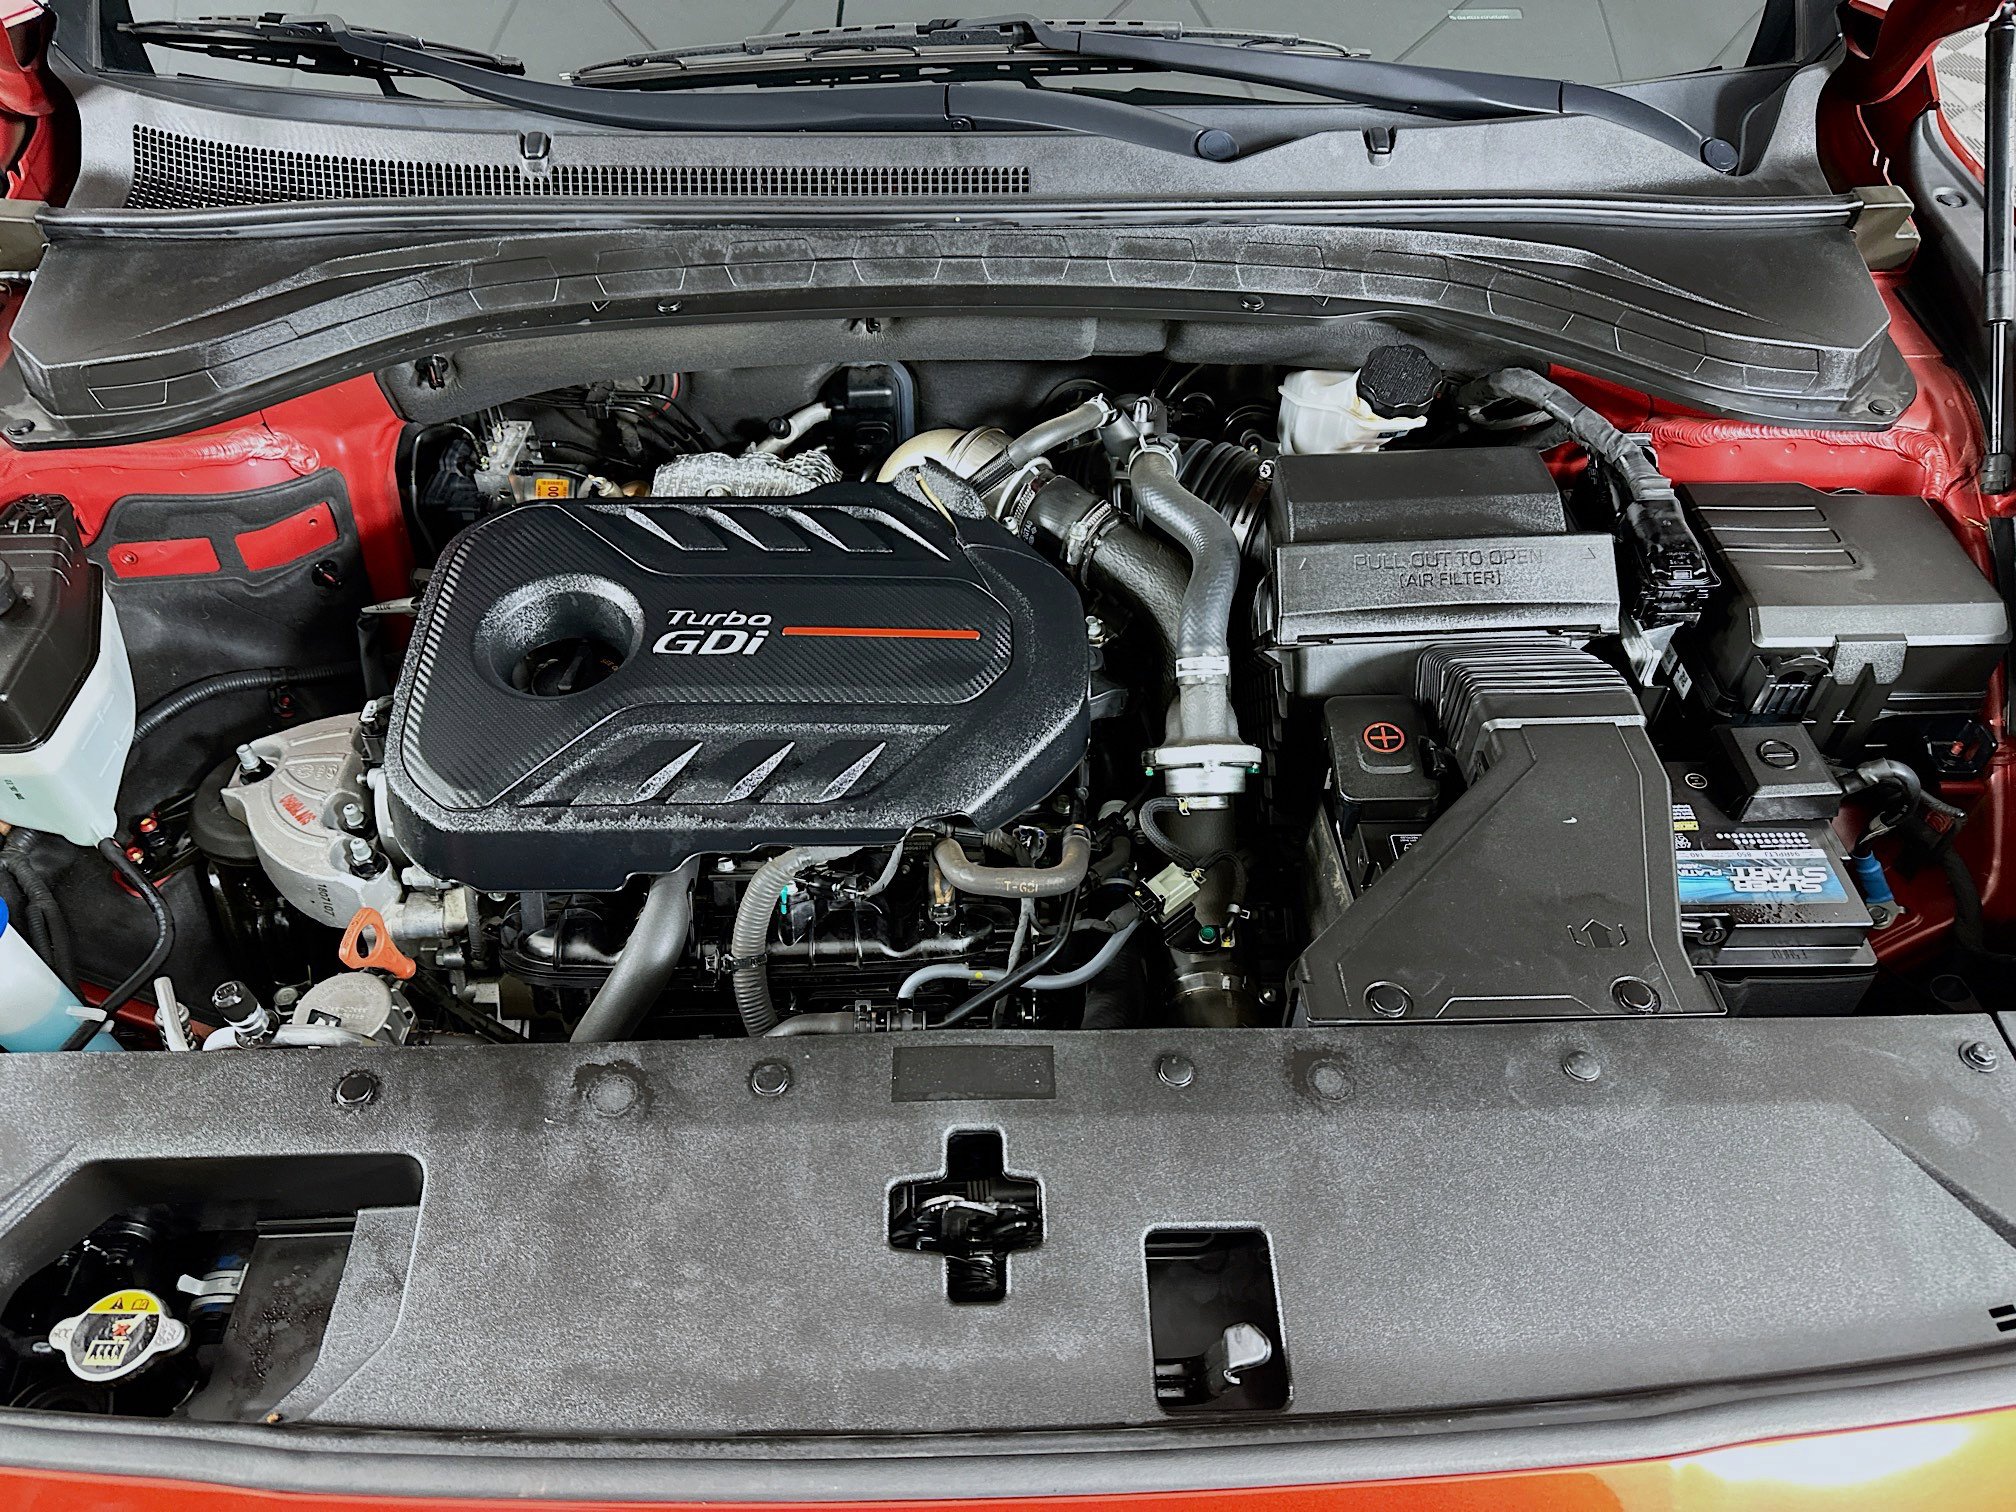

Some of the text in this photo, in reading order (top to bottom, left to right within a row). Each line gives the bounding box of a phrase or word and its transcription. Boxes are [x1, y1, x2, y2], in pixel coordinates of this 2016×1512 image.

[1353, 548, 1543, 570] PULL OUT TO OPEN
[667, 609, 772, 626] Turbo
[652, 630, 770, 655] GDi
[1728, 866, 1828, 882] START
[1733, 880, 1823, 893] SUPER
